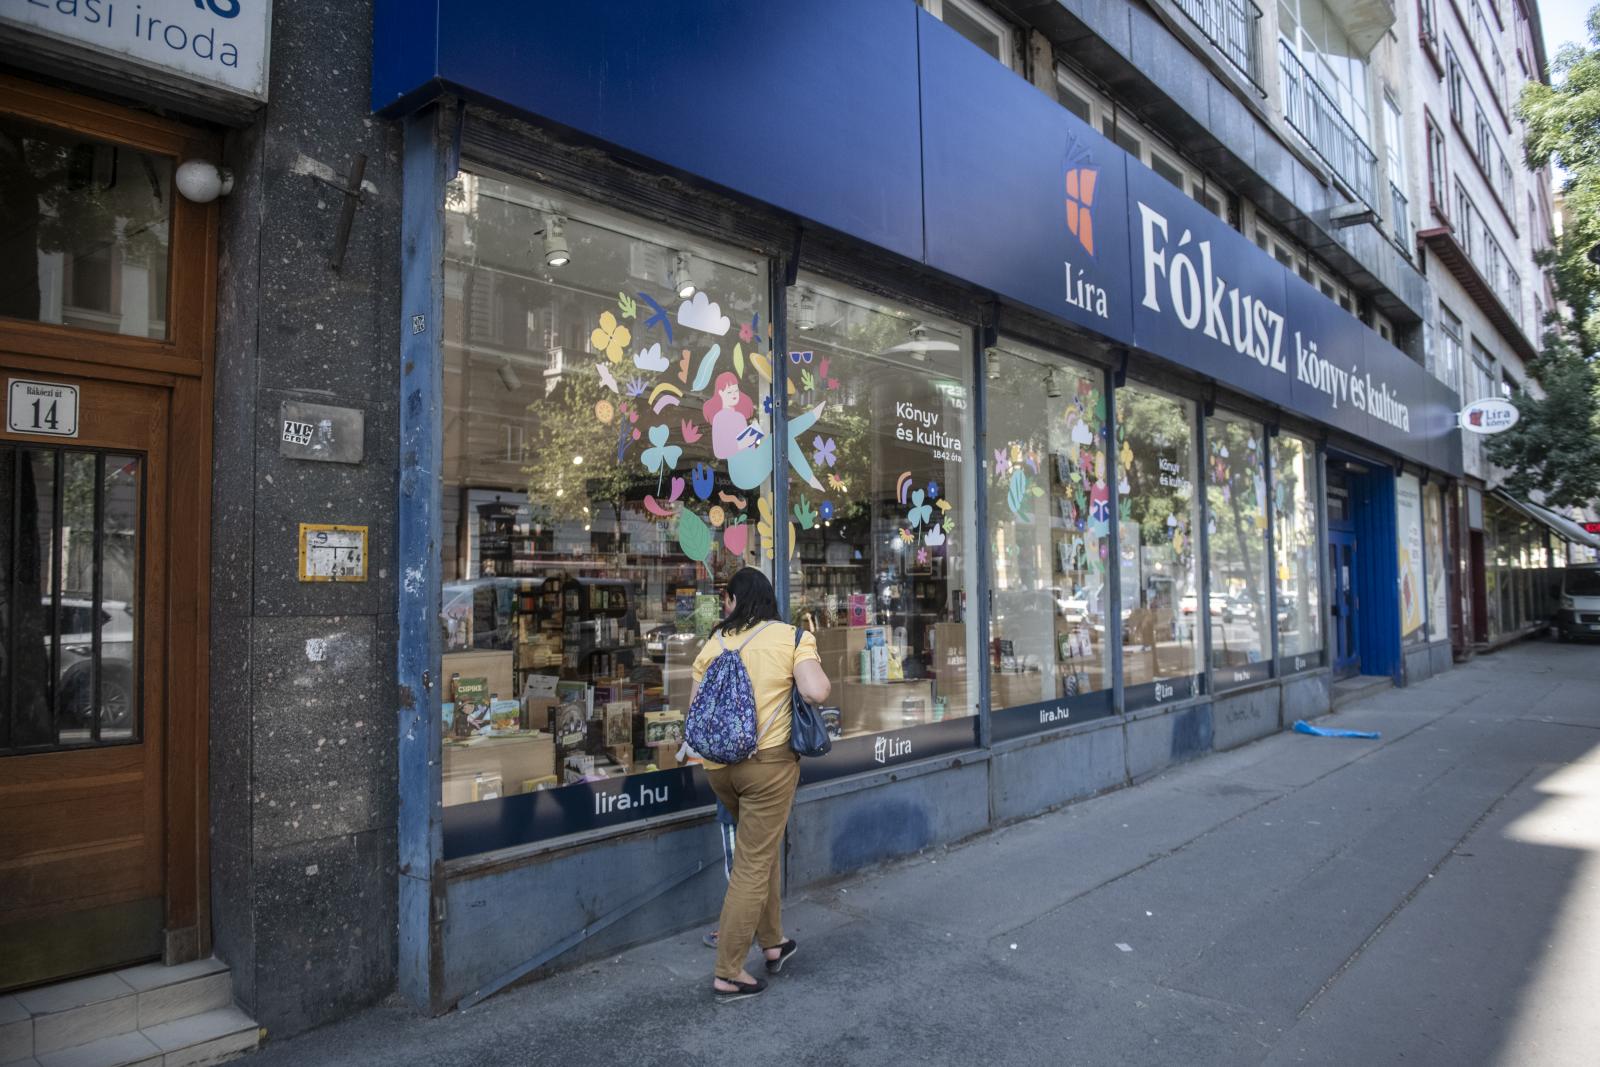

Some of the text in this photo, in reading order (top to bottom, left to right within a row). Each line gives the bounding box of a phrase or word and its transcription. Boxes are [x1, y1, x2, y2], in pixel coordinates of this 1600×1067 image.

[136, 5, 239, 68] iroda
[1064, 261, 1108, 319] Líra
[1137, 201, 1409, 433] Fókusz könyv és kultúra
[31, 398, 59, 430] 14
[896, 401, 939, 428] Könyv
[285, 422, 312, 436] ZVC
[896, 422, 961, 451] és kultúra
[933, 450, 962, 463] 1842 óta
[1040, 706, 1069, 723] lira.hu
[889, 737, 912, 758] Líra
[595, 784, 668, 815] lira.hu
